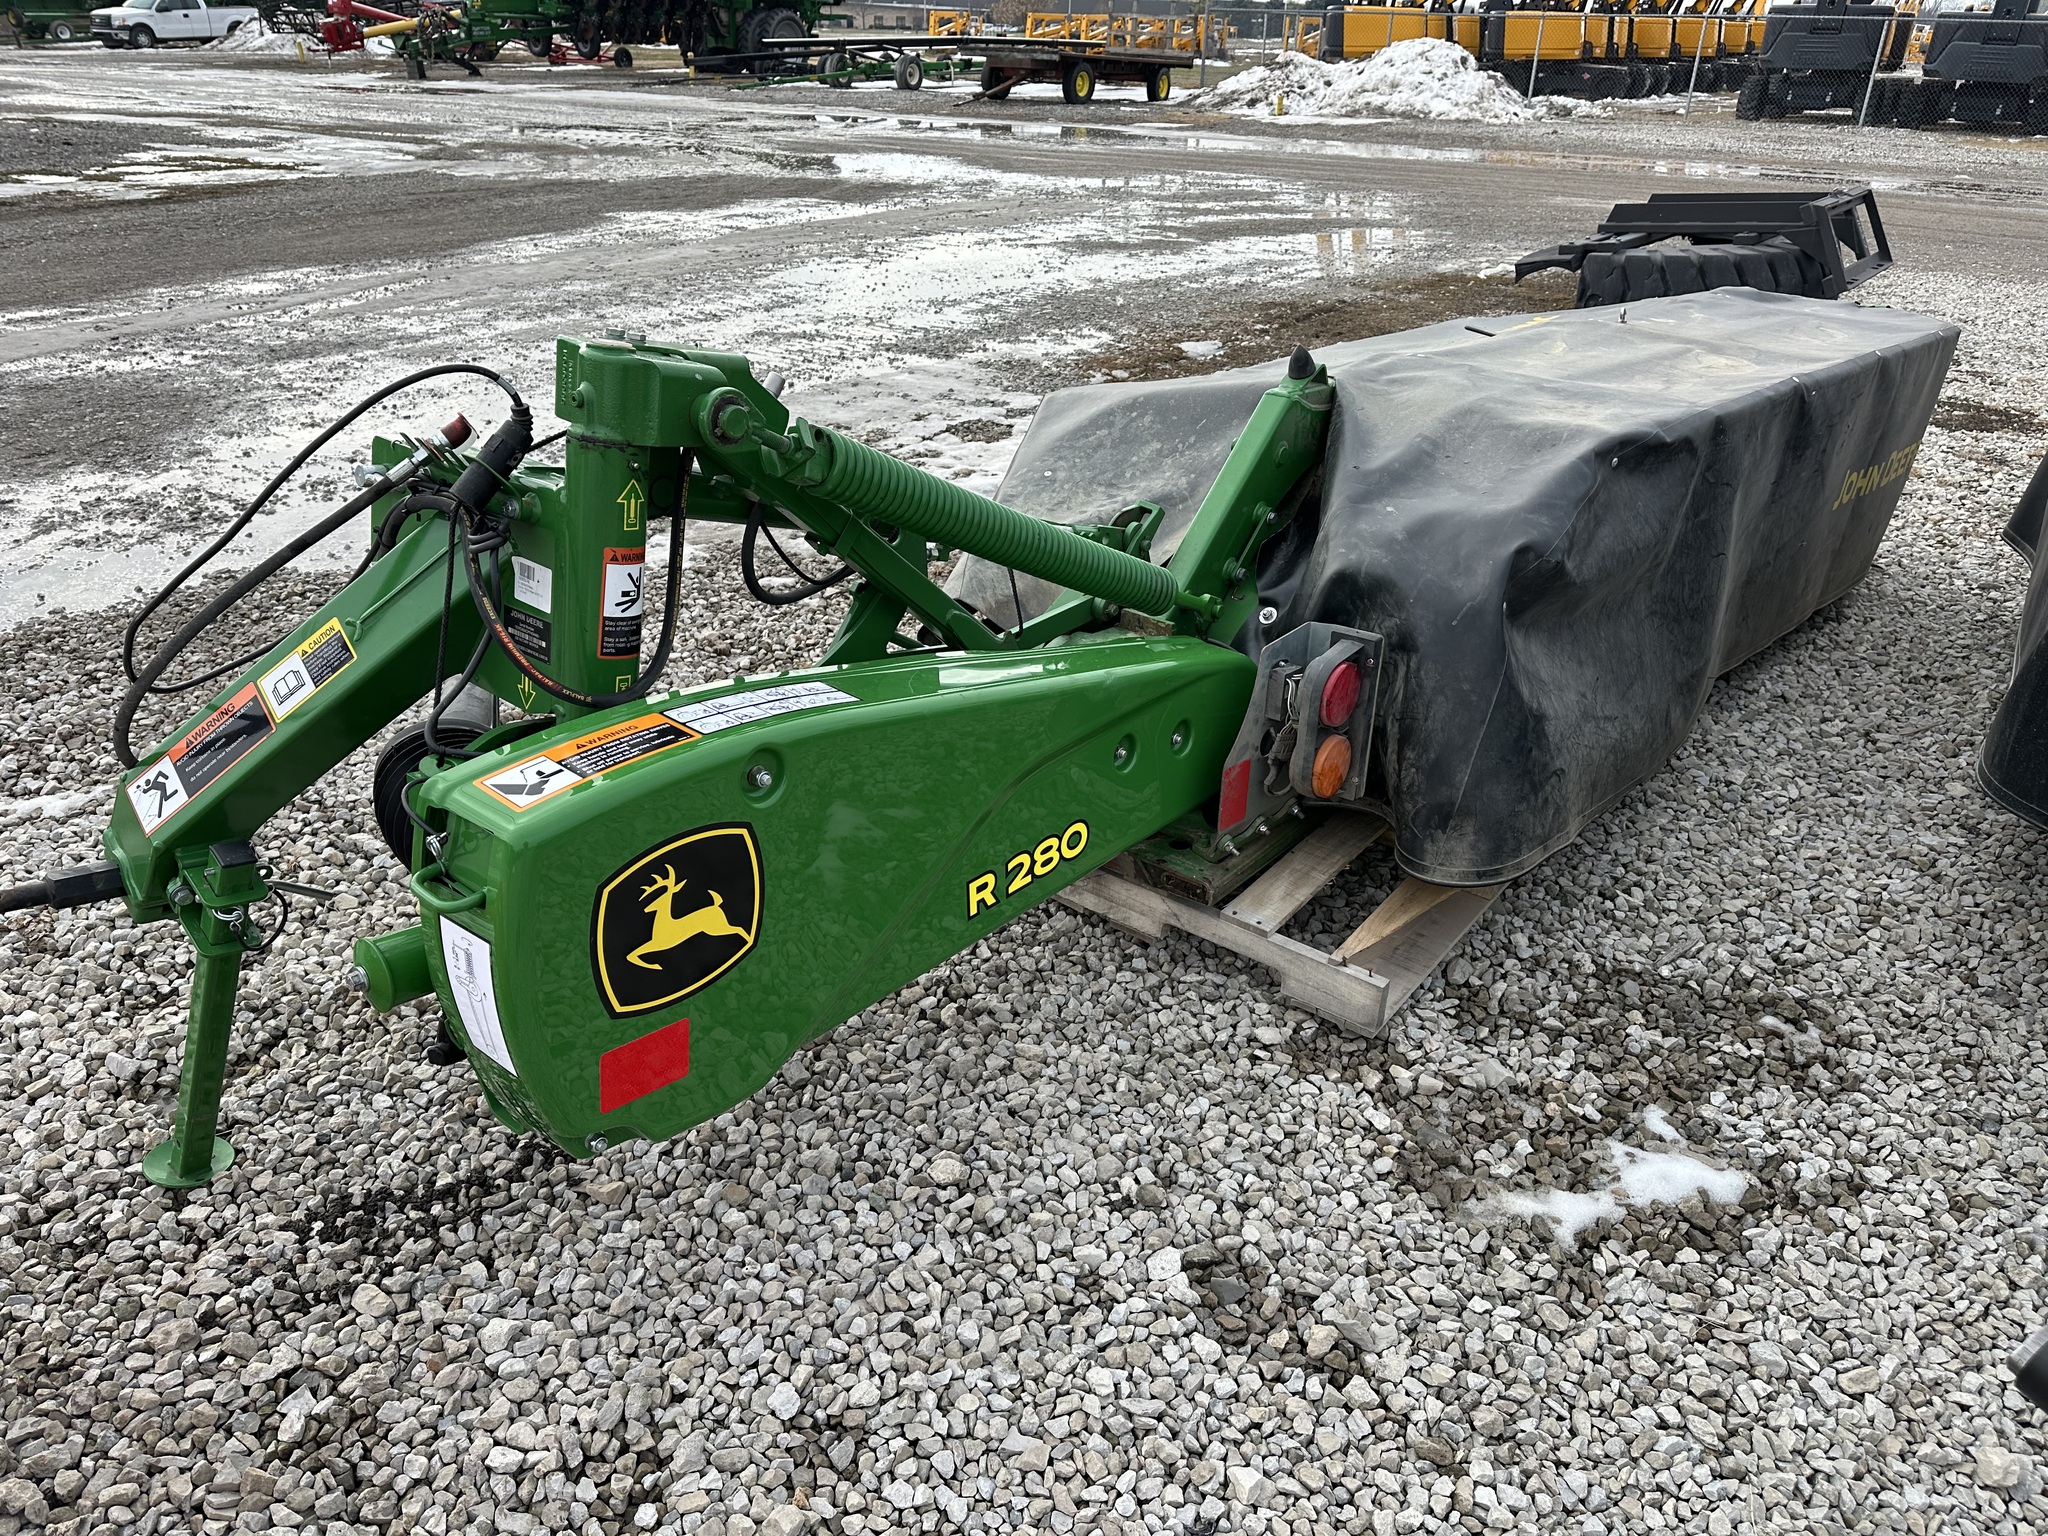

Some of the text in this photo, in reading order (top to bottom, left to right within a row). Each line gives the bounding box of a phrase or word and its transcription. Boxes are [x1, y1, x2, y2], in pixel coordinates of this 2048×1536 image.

[1832, 441, 1921, 511] JOHN DEER
[511, 609, 525, 621] JOHN
[309, 626, 335, 650] CAUTION
[562, 689, 584, 701] BALFLEX
[192, 702, 235, 742] WARNING
[203, 732, 216, 744] FROM
[585, 725, 638, 745] WARNING
[967, 820, 1089, 920] R 280
